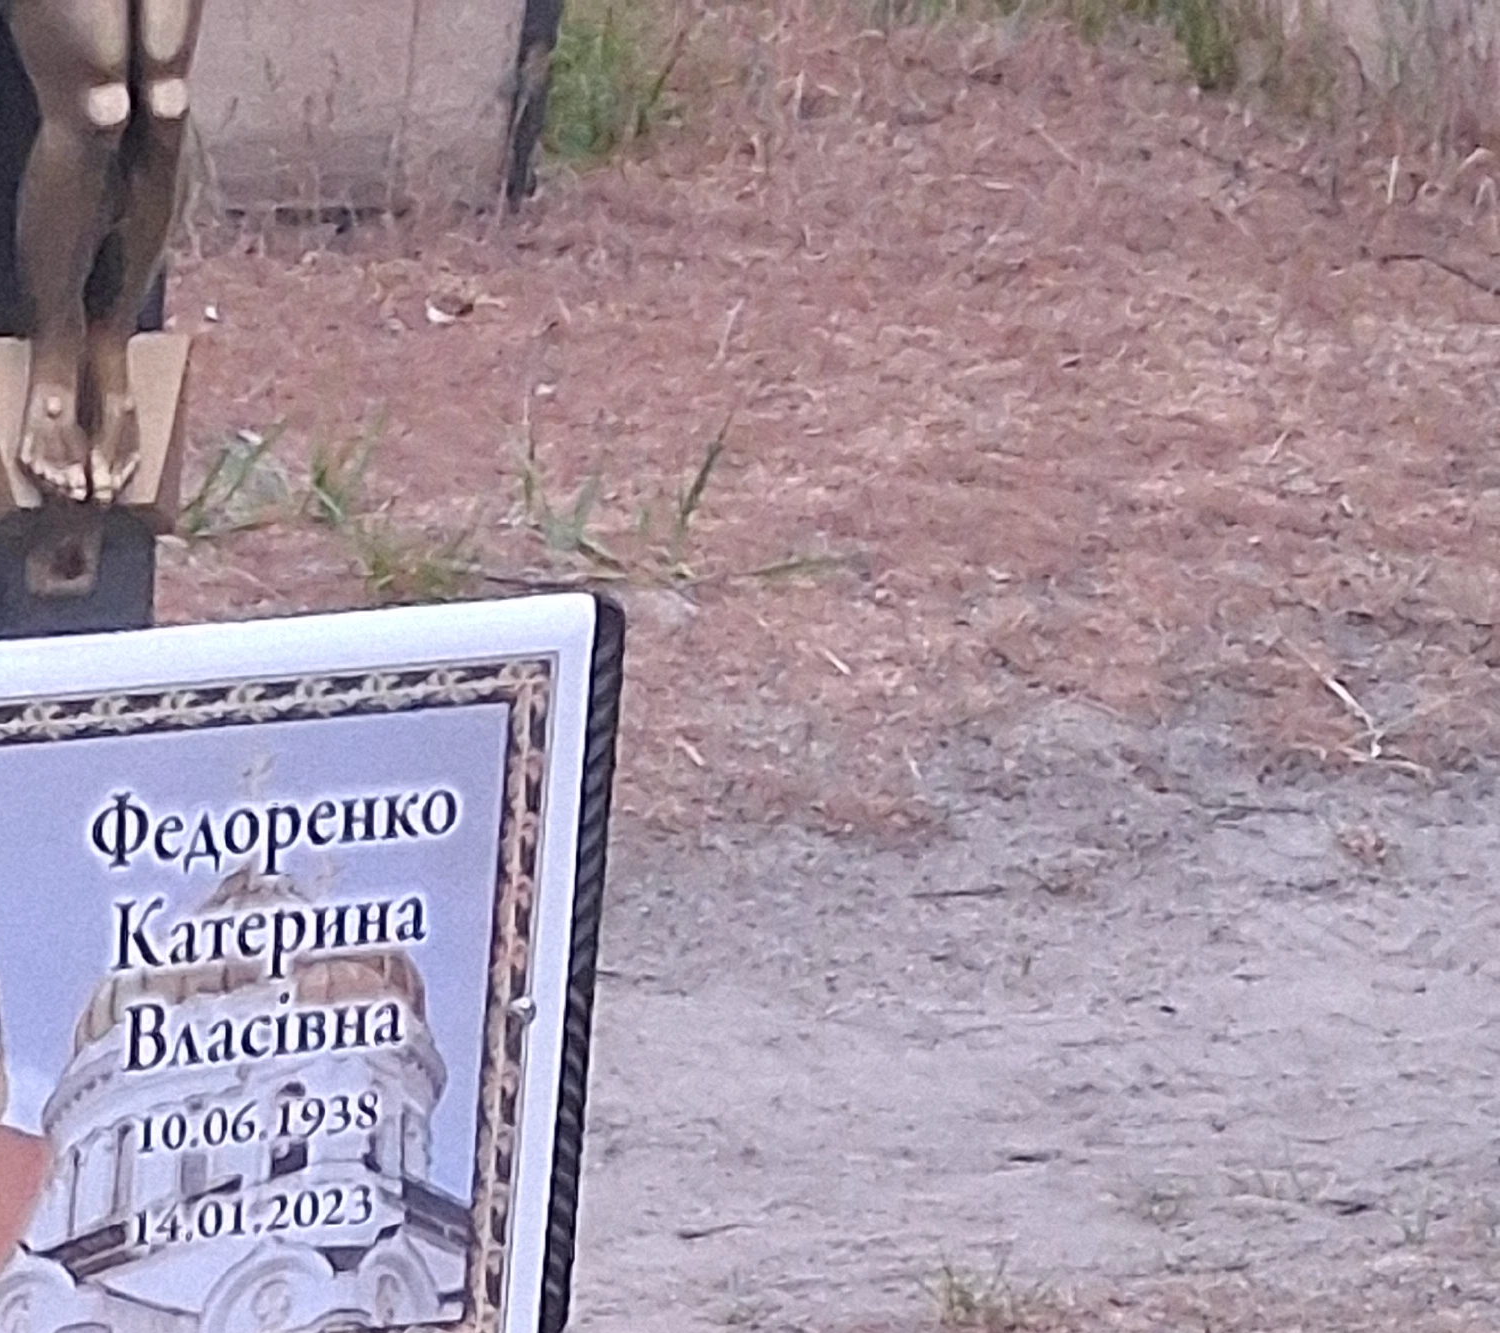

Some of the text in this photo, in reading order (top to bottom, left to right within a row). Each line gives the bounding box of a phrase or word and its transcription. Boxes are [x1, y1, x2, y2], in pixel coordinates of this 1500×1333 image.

[91, 790, 458, 876] Федоренко
[111, 895, 427, 980] Катерина
[122, 991, 404, 1072] Власівна
[138, 1091, 379, 1153] 10.06.1938
[134, 1184, 374, 1245] 14.01.2023
